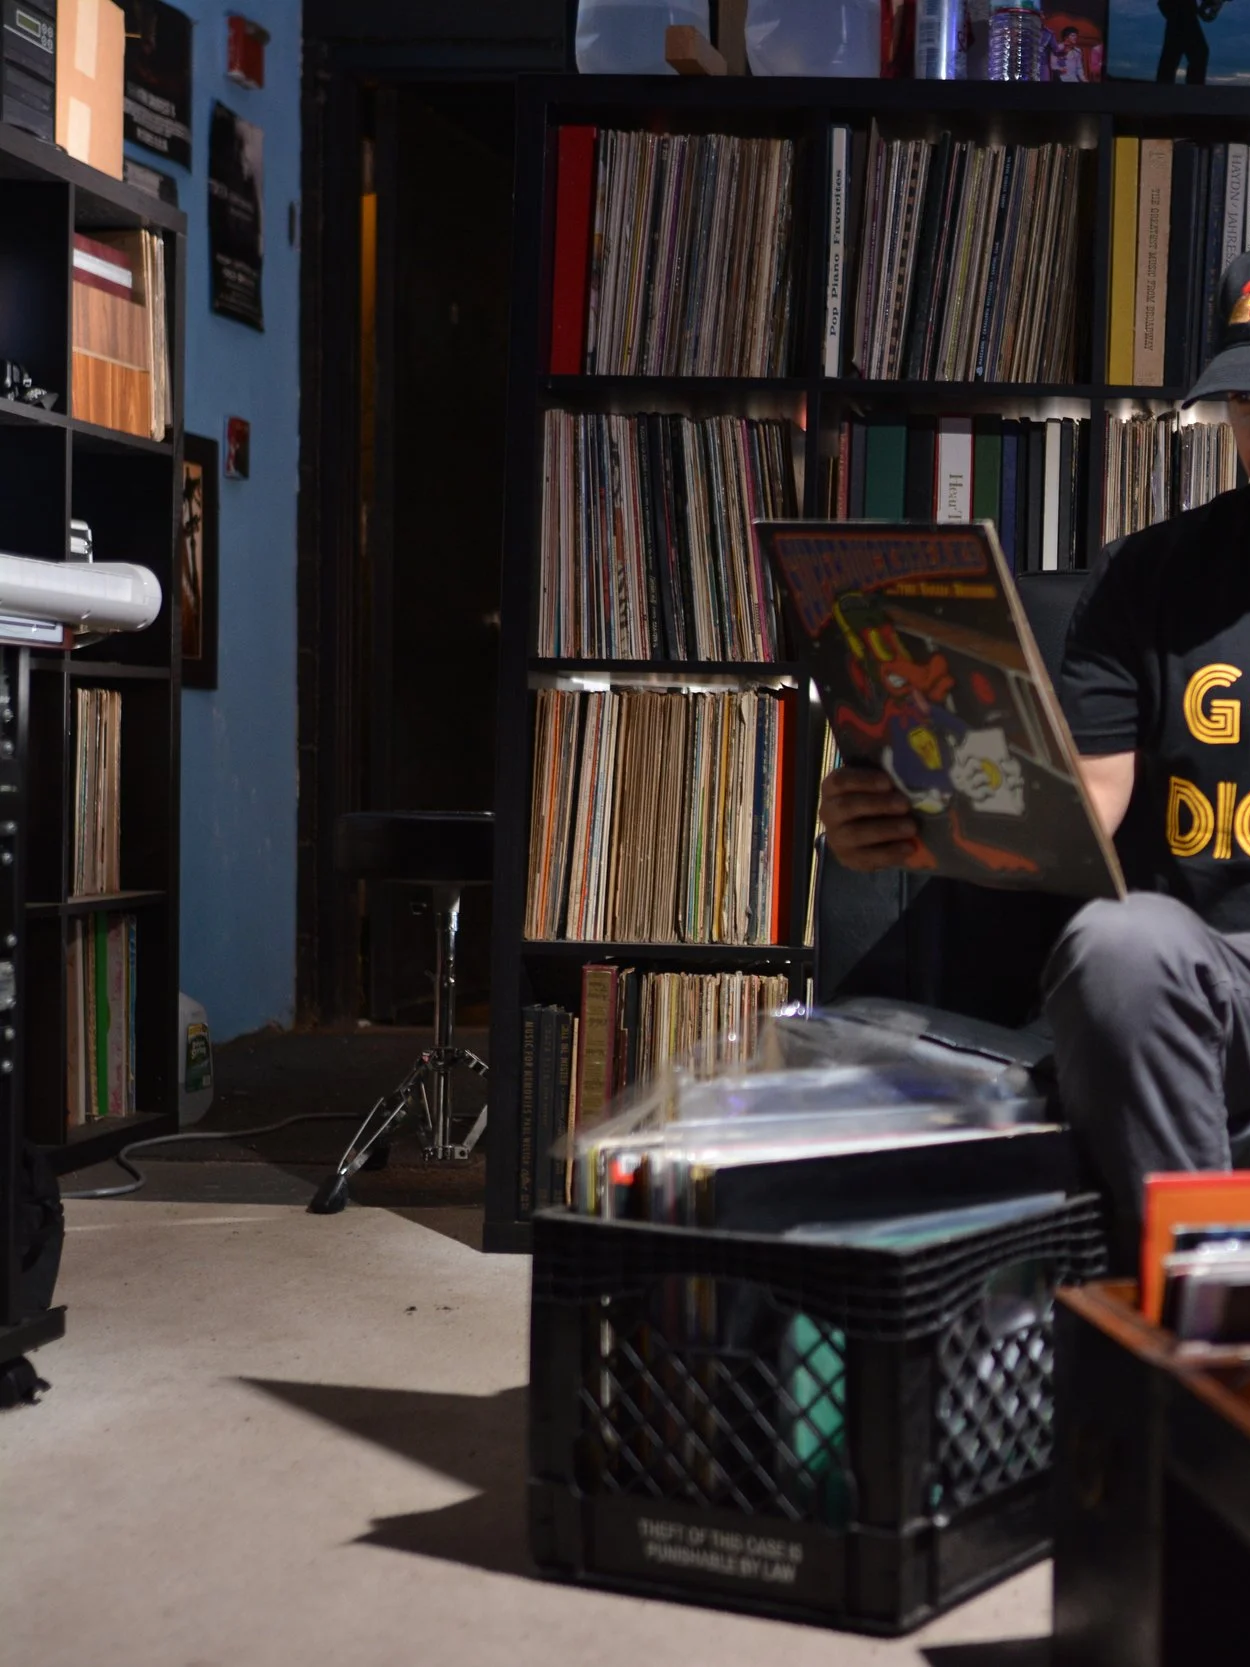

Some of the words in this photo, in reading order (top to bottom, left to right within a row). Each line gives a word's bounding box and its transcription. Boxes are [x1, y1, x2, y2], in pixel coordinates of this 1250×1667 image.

[1151, 188, 1160, 206] THE
[1230, 154, 1243, 204] HAYDN
[833, 169, 842, 244] Favorites
[1149, 207, 1160, 250] GREATEST
[831, 253, 840, 298] Piano
[1147, 251, 1159, 276] MUSIC
[1146, 277, 1157, 303] FROM
[830, 306, 839, 336] Pop
[1144, 304, 1155, 351] BROADWAY
[523, 1021, 534, 1048] MUSIC
[523, 1050, 533, 1067] FOR
[637, 1517, 684, 1544] THEFT
[687, 1526, 706, 1547] OF
[709, 1528, 744, 1551] THIS
[746, 1534, 786, 1557] CASE
[788, 1541, 803, 1564] IS
[646, 1542, 736, 1576] PUNISHABLE
[739, 1557, 762, 1579] BY
[763, 1562, 797, 1584] LAW
